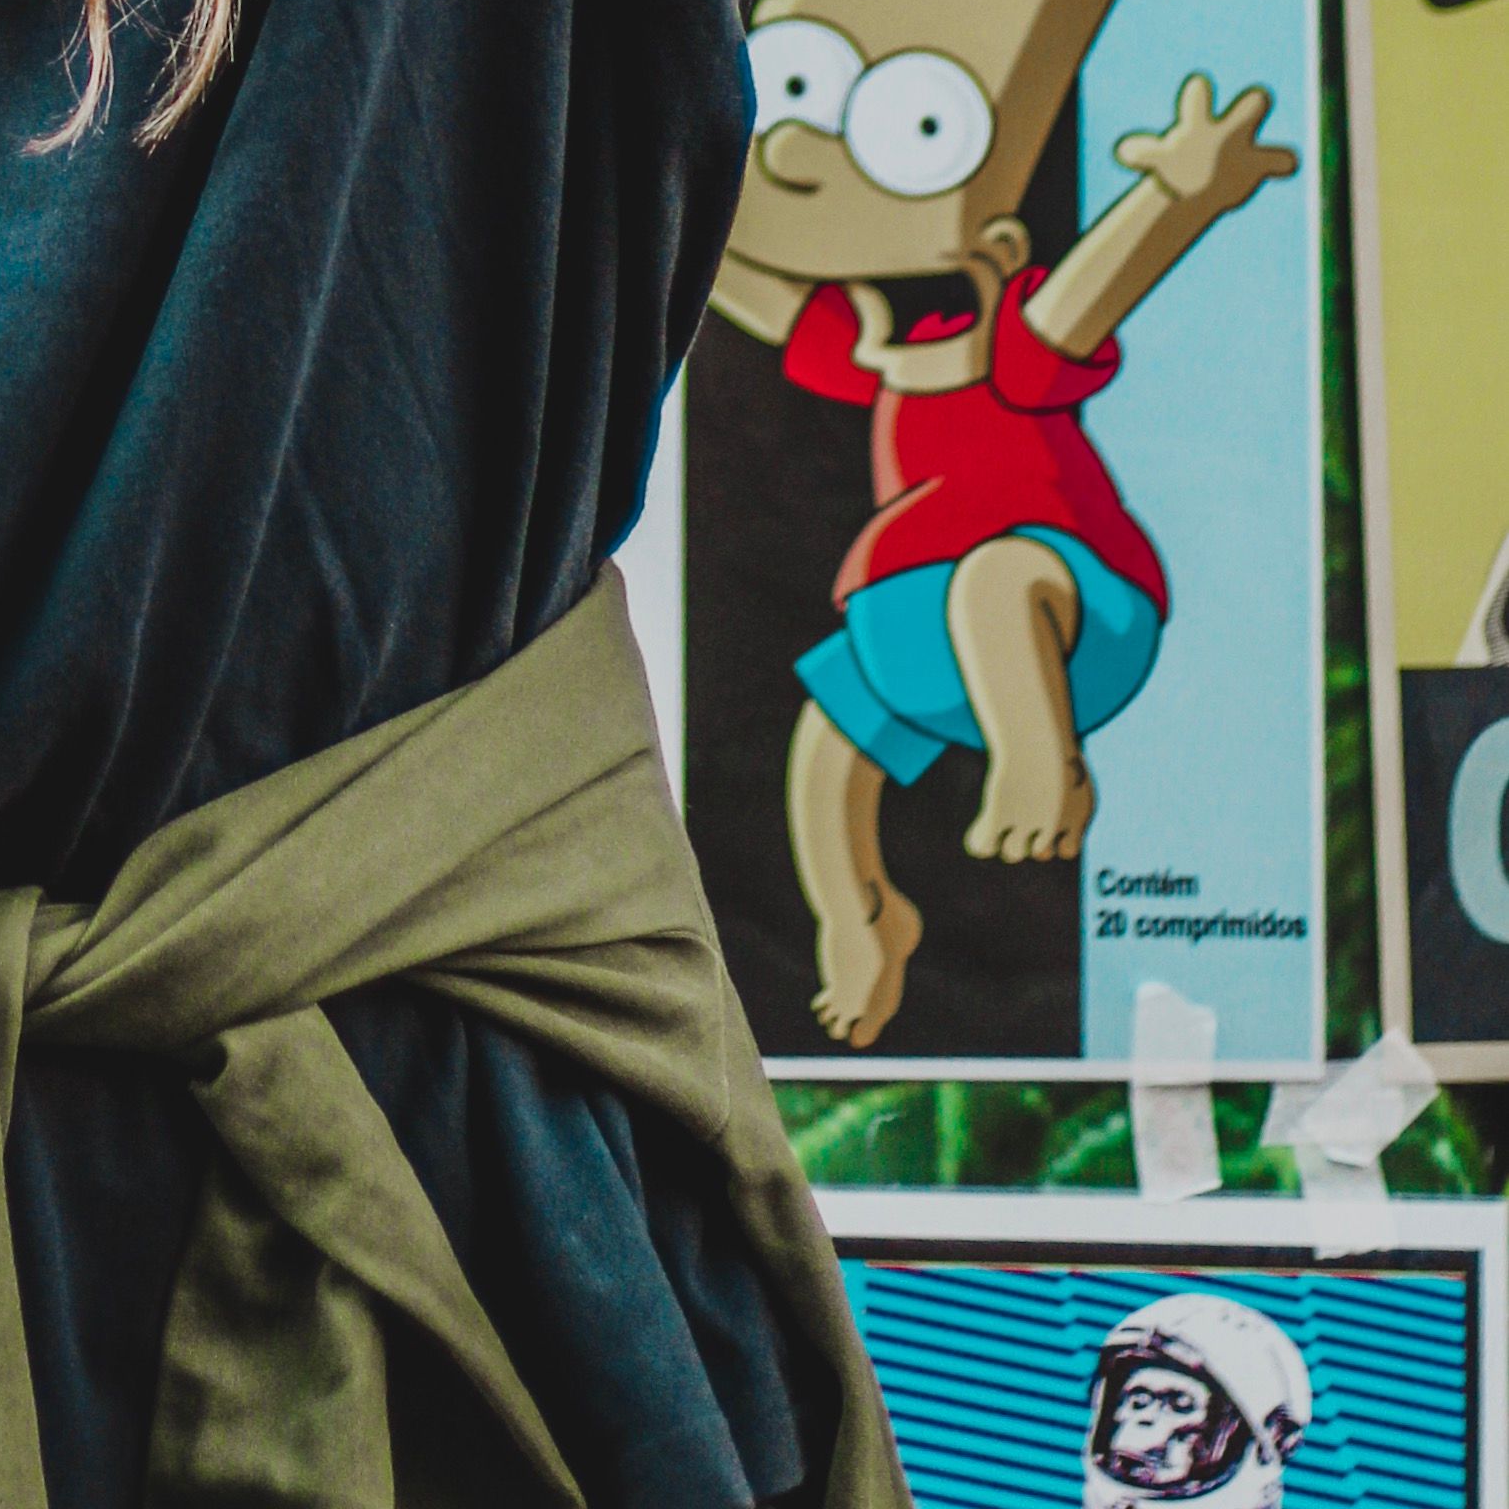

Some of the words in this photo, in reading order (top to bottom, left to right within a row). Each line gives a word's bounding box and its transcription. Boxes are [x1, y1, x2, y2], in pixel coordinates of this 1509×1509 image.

[1096, 867, 1201, 898] Contém
[1096, 907, 1127, 939] 20
[1134, 906, 1309, 947] comprimidos
